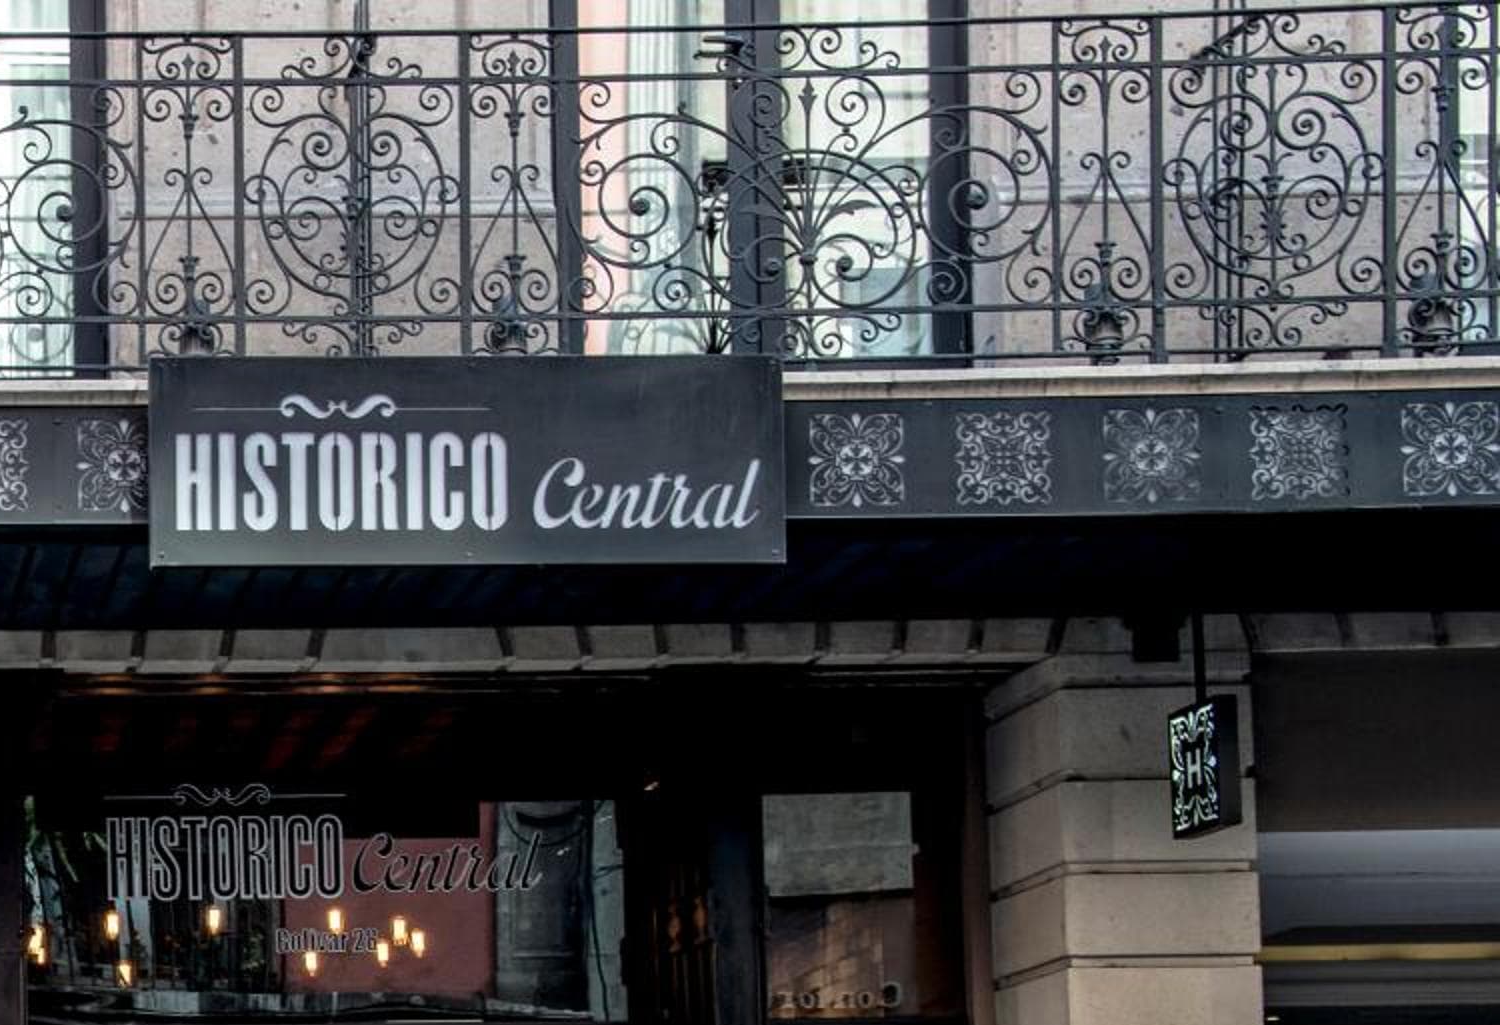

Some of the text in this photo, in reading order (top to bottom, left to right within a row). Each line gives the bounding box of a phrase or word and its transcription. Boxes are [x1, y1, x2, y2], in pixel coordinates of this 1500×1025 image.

[176, 431, 761, 532] HISTORICO Central
[105, 814, 543, 900] HISTORICO Central
